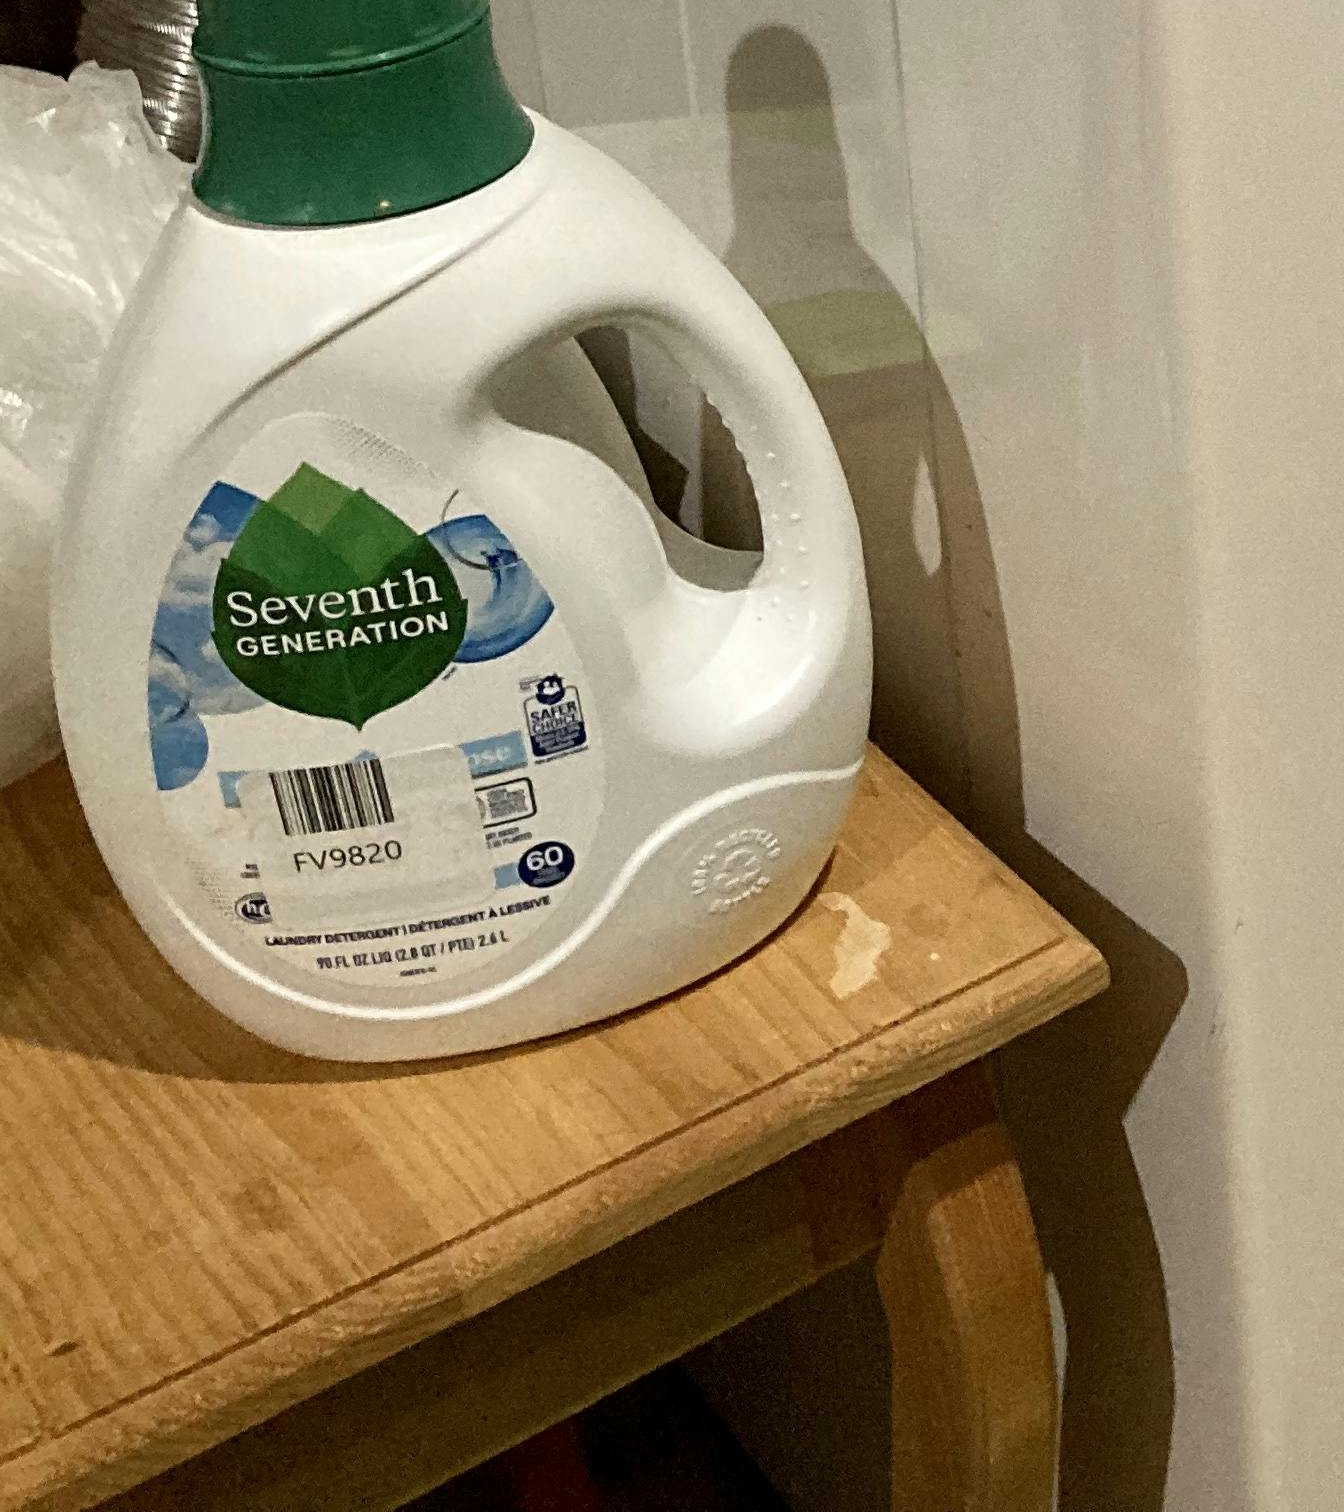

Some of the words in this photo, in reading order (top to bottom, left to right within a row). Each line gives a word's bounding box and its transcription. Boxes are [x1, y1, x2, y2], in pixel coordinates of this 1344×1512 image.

[226, 568, 443, 627] Seventh
[236, 611, 449, 657] GENERATION
[293, 840, 402, 873] FV9820
[525, 845, 563, 871] 60
[264, 934, 322, 947] LAUNDRY
[325, 926, 401, 944] DETERGENT
[408, 911, 486, 934] DÉTERGENT
[500, 895, 551, 916] LESSIVE
[335, 955, 351, 969] FL
[353, 953, 369, 967] OZ
